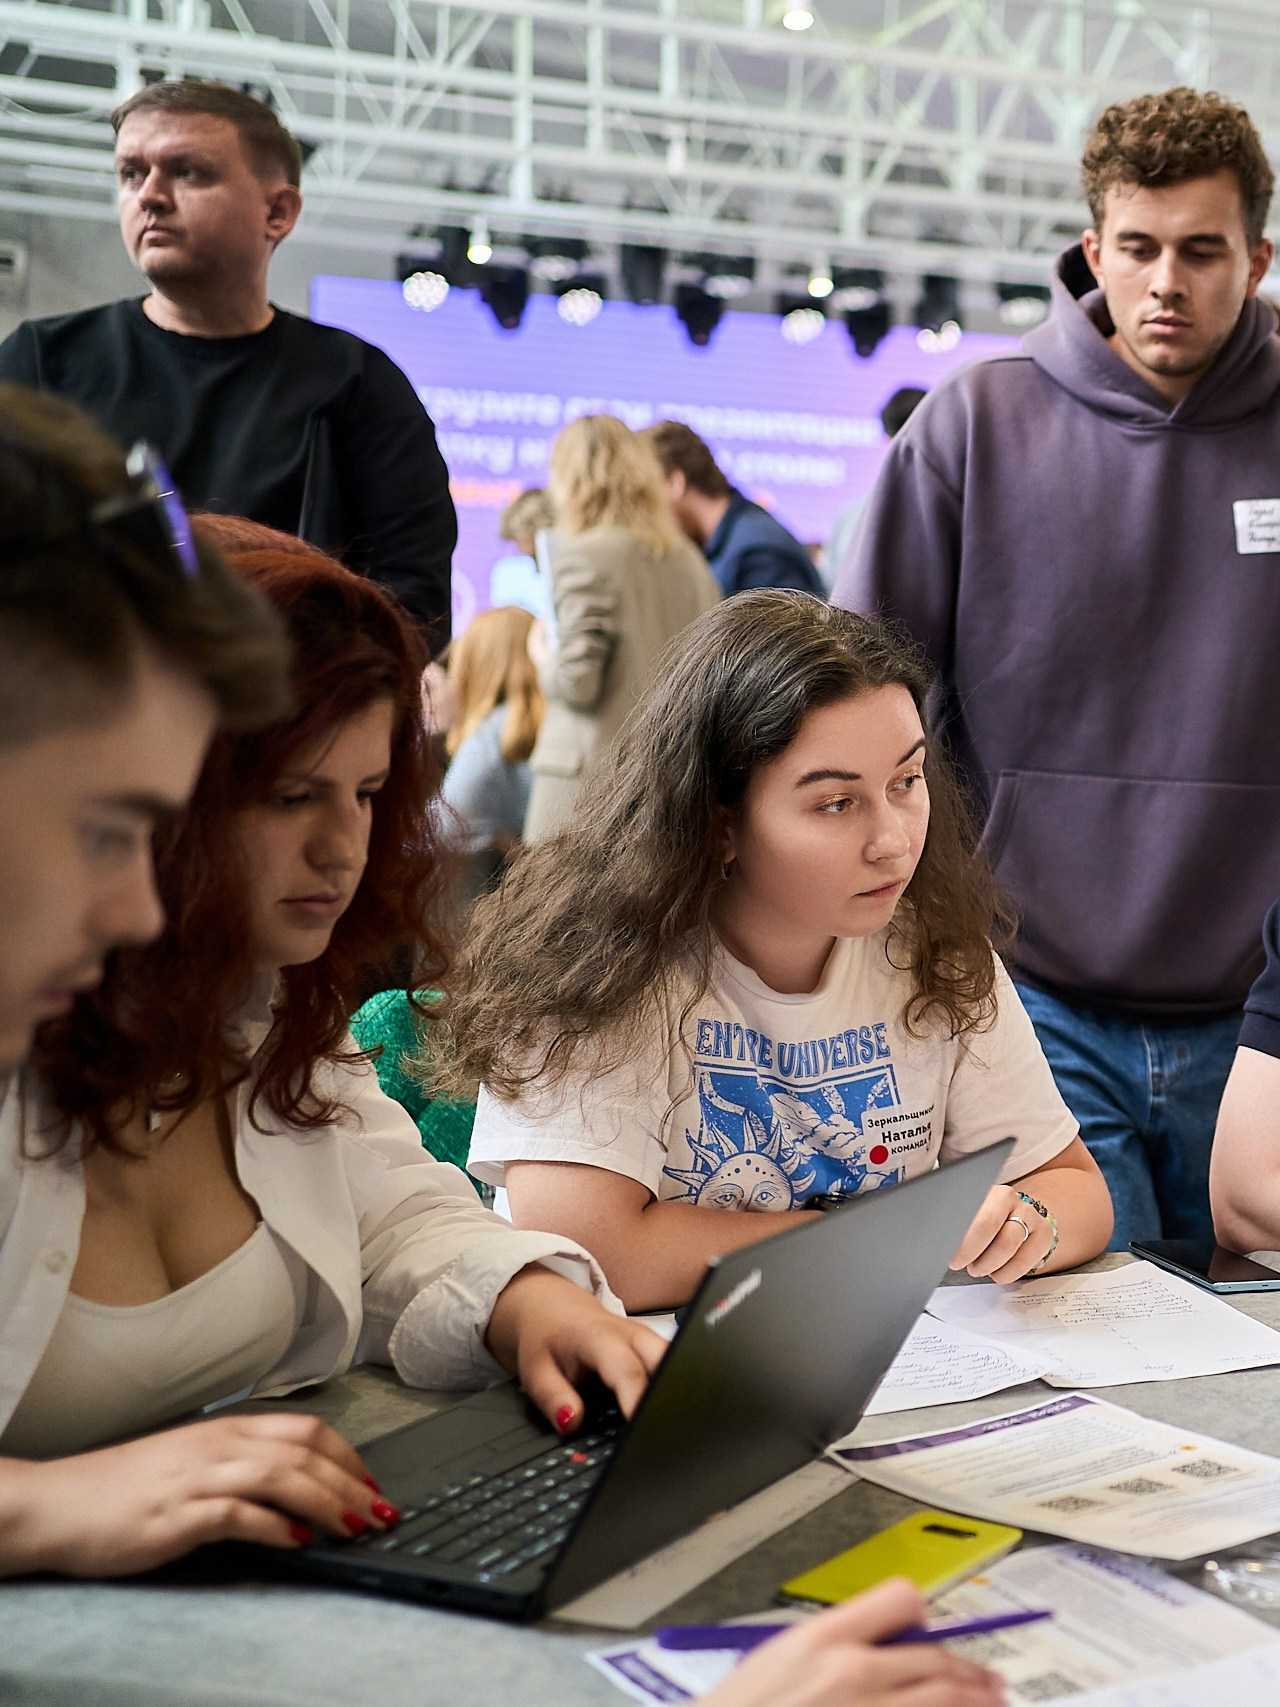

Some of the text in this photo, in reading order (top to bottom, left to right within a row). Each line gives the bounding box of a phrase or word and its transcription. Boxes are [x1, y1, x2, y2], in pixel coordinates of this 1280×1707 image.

[695, 1018, 892, 1079] ENTRE UNIVERSE
[891, 1138, 928, 1155] КОМАНДА
